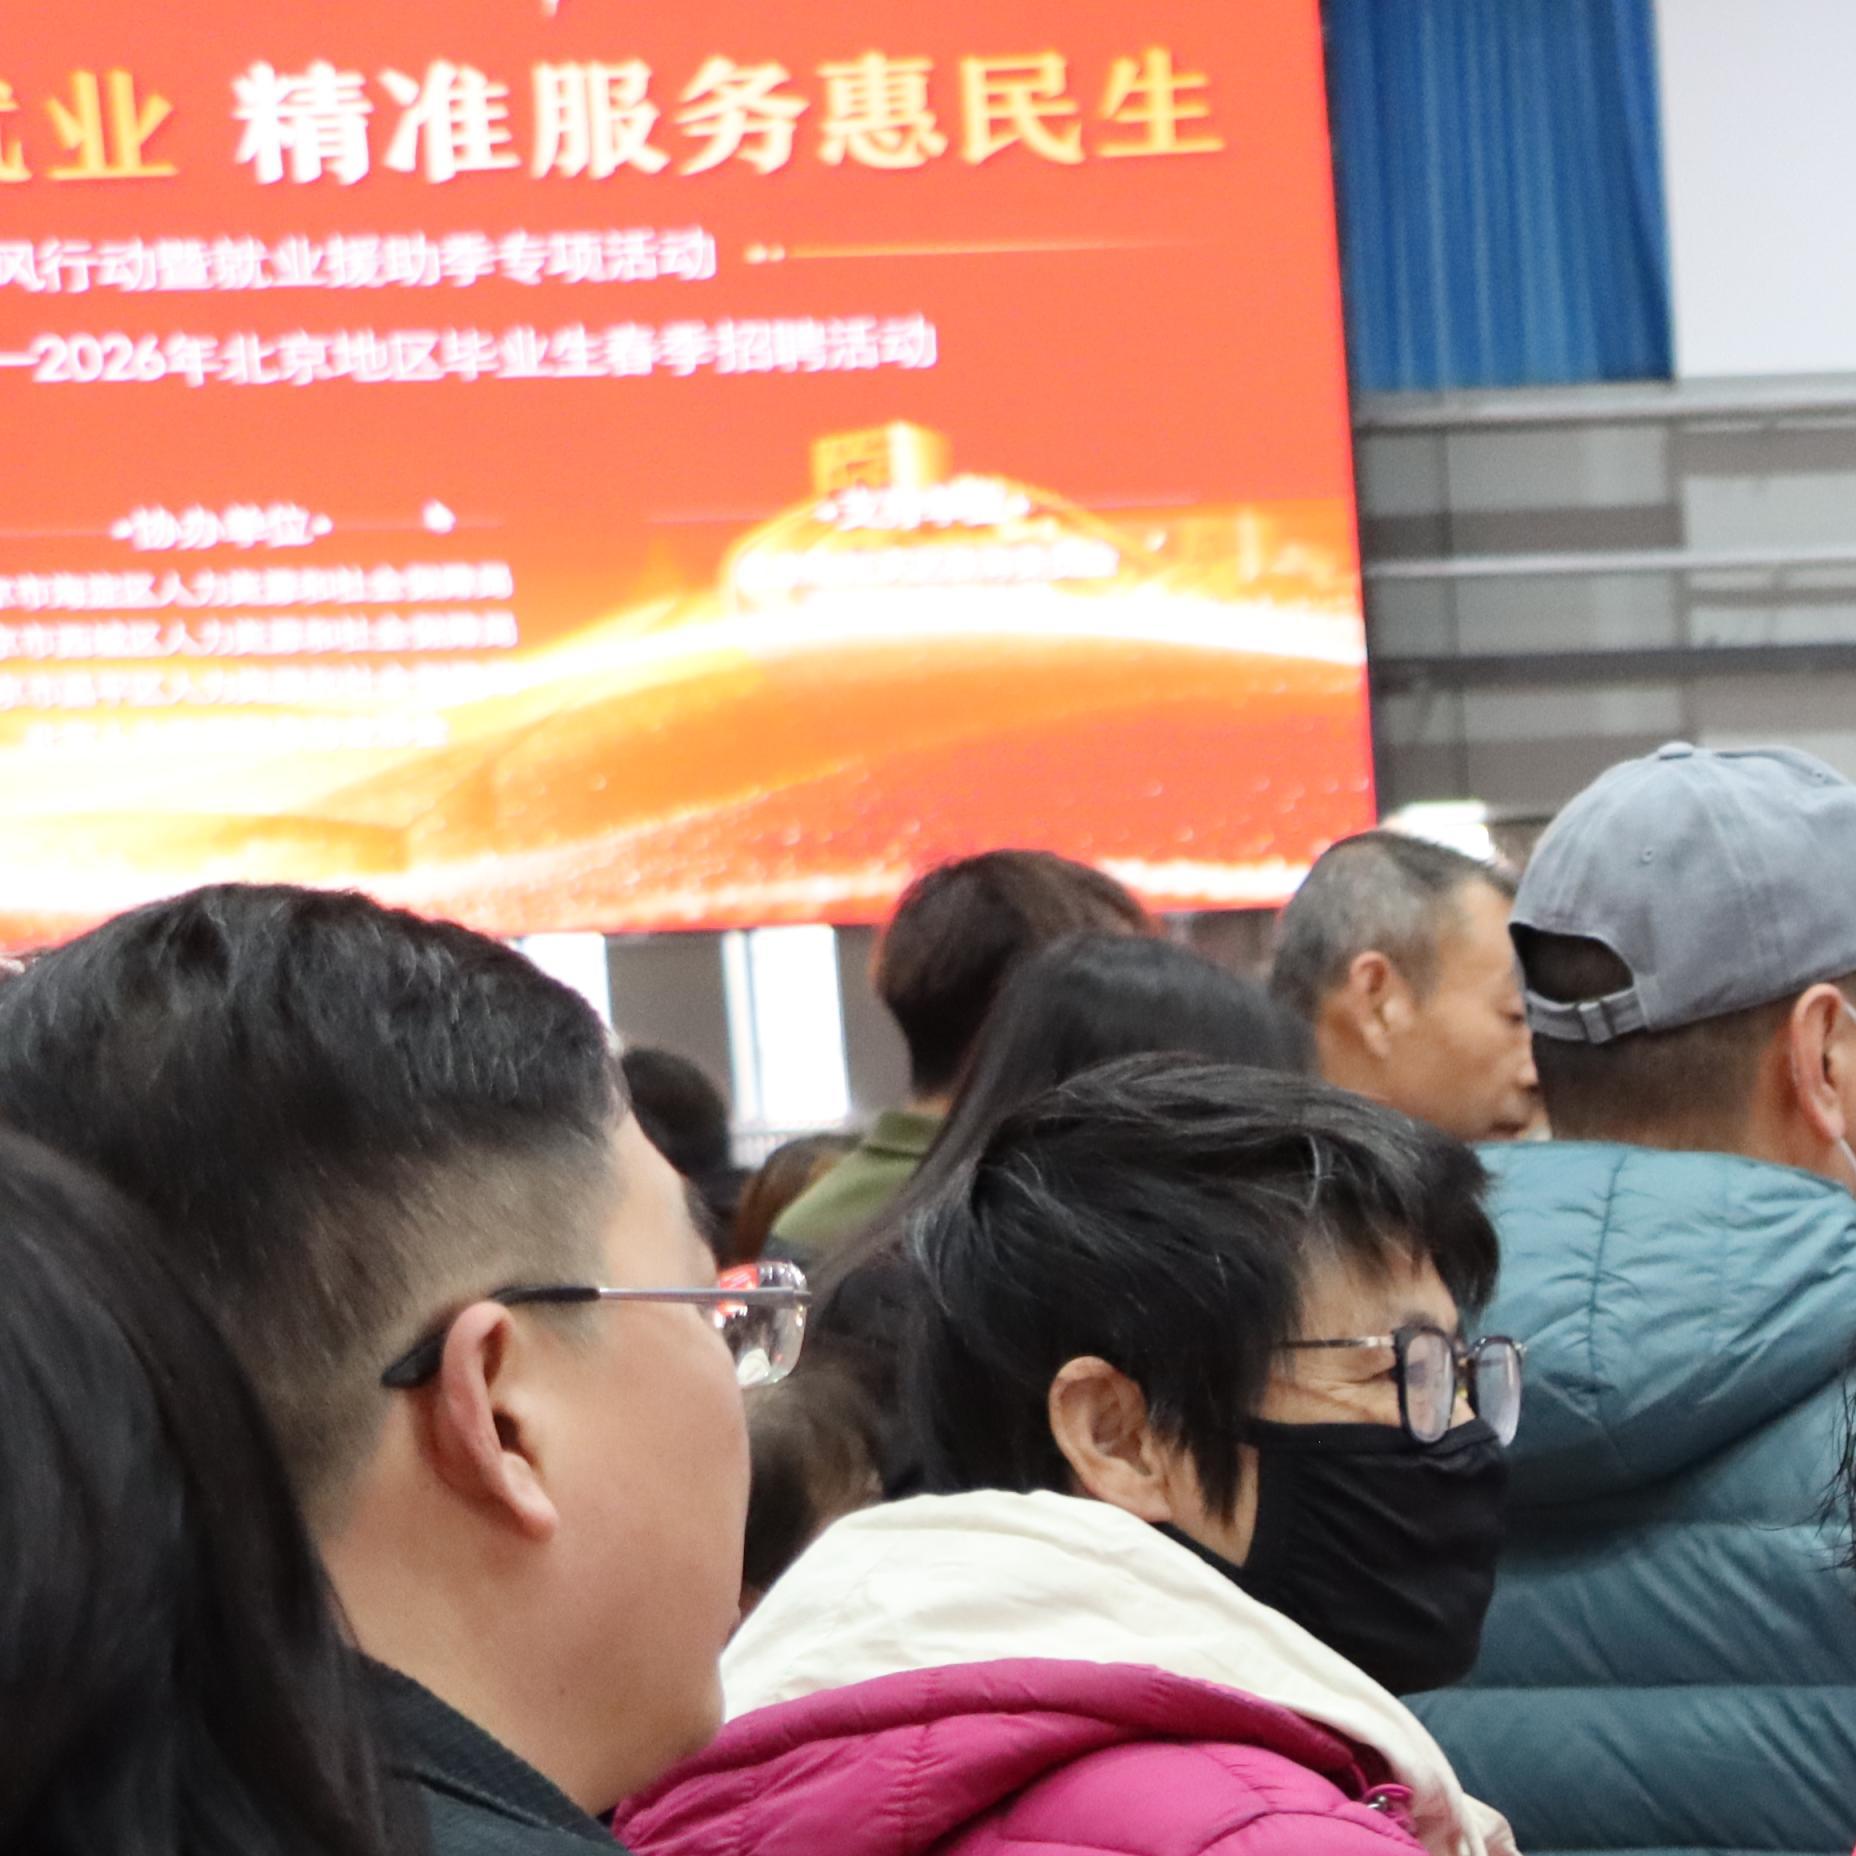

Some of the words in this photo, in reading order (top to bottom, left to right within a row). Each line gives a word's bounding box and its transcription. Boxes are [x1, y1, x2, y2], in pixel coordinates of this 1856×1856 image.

[230, 47, 1228, 185] 精准服务惠民生
